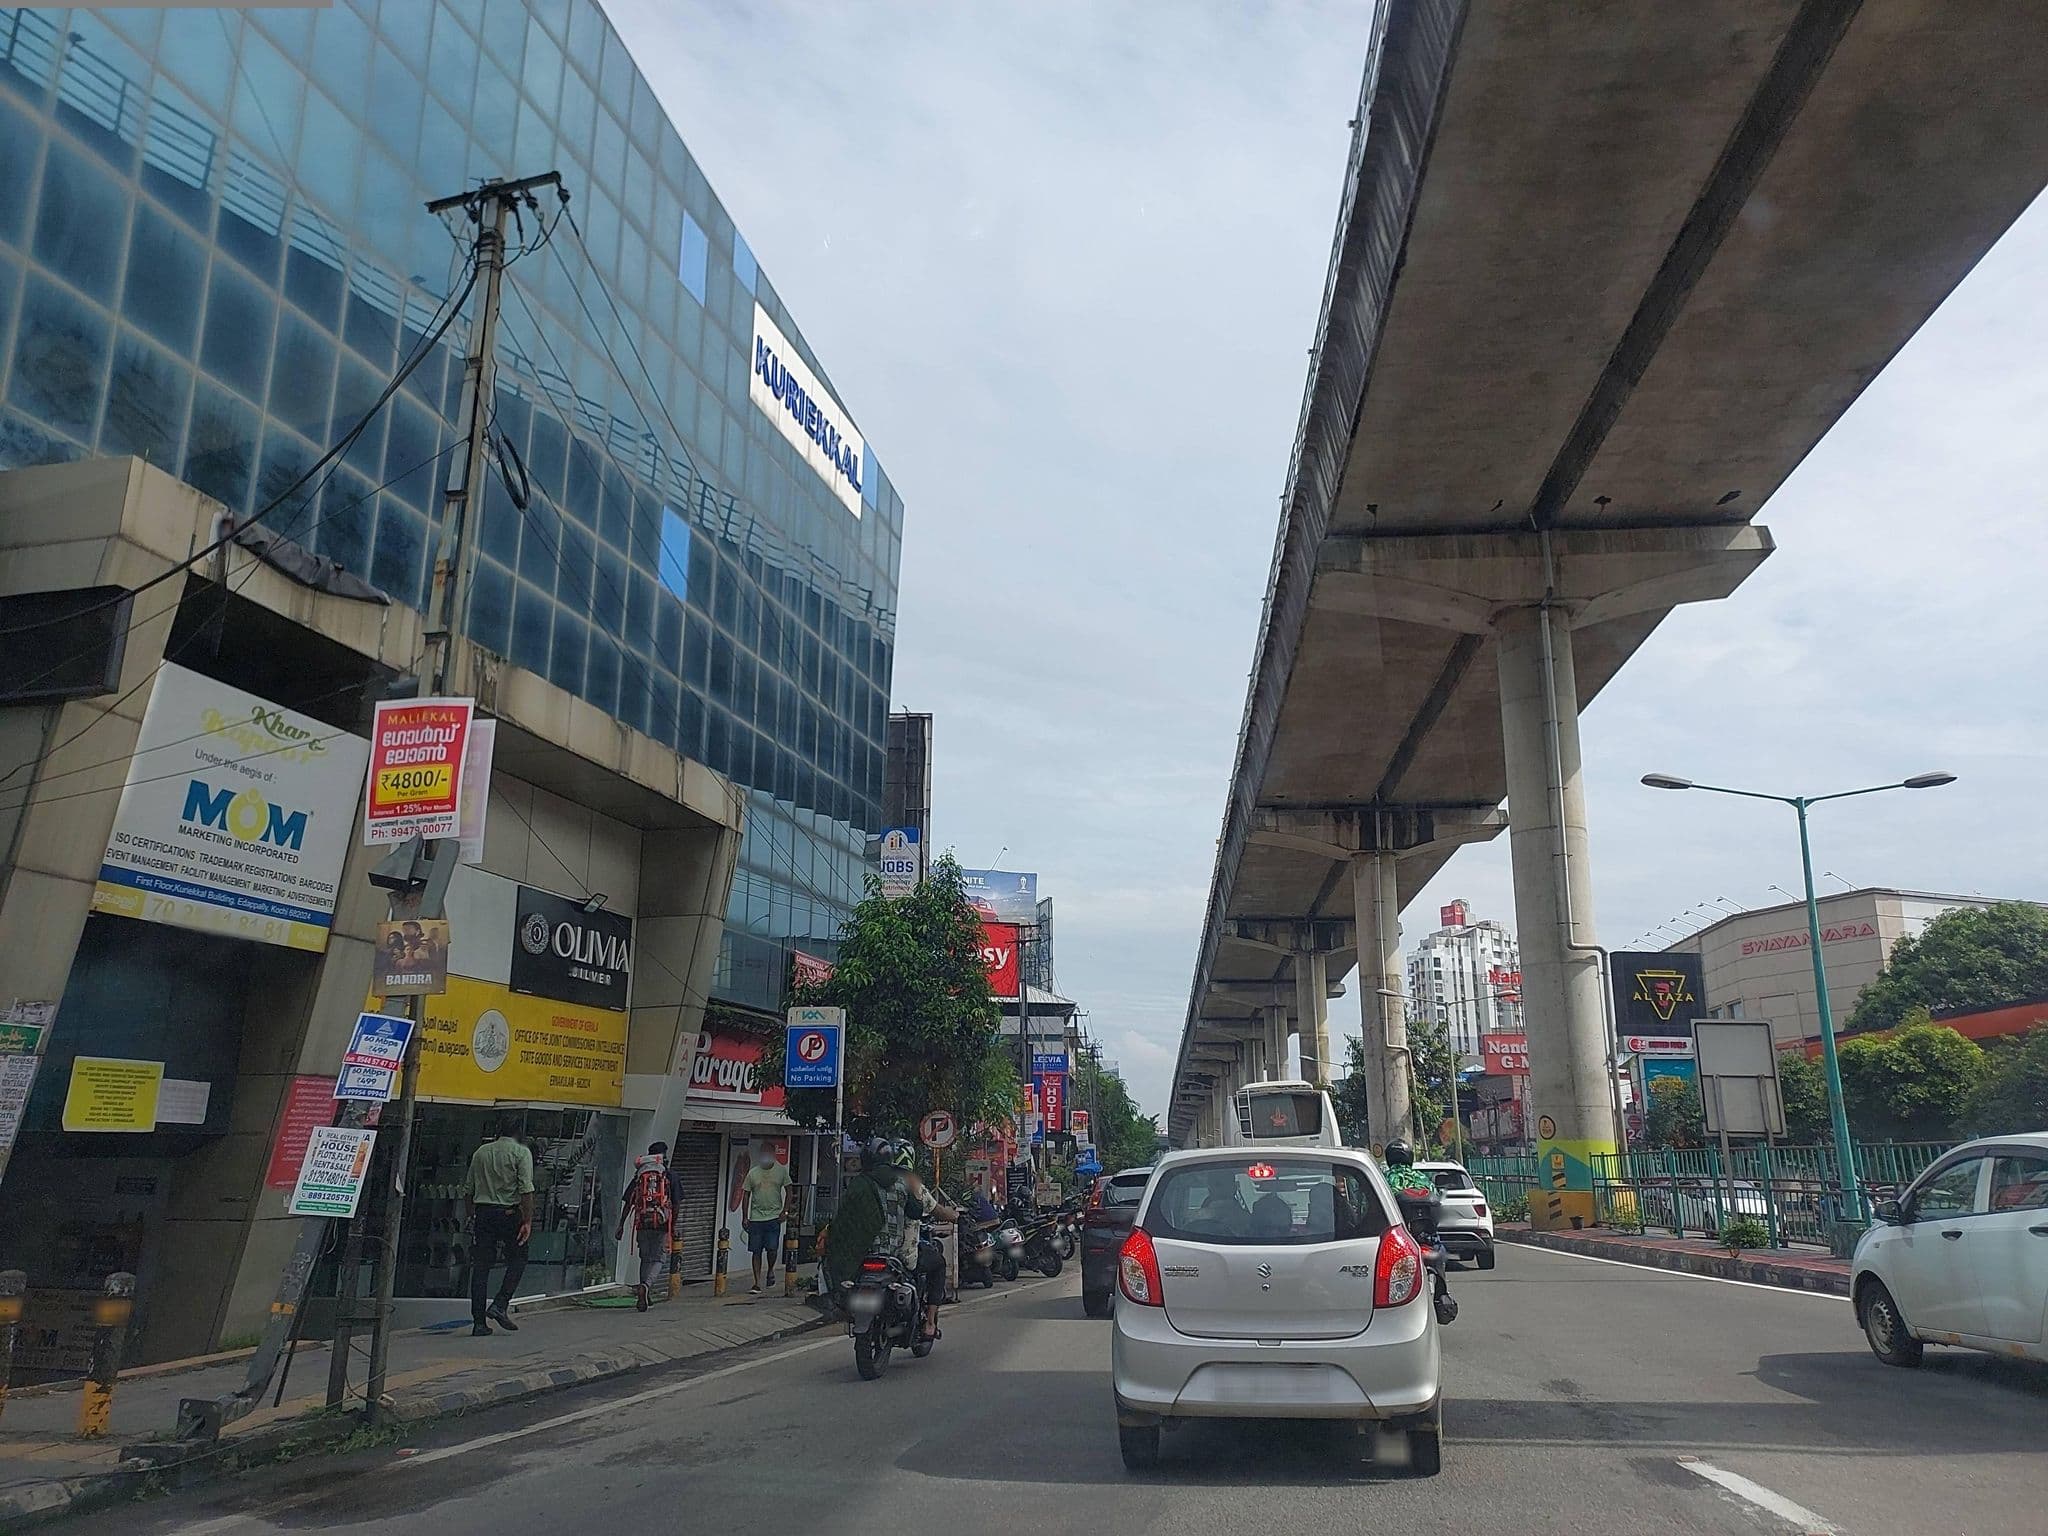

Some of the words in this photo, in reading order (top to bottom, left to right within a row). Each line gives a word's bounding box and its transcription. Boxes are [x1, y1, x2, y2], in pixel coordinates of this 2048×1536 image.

[756, 334, 861, 494] KURIEKKAL
[387, 711, 457, 726] MALIEKAL
[195, 748, 223, 766] Under
[240, 764, 262, 779] aegis
[182, 779, 309, 850] MOM
[396, 803, 422, 814] 1.25%
[422, 822, 453, 834] 00077
[178, 824, 233, 847] MARKETING
[233, 839, 299, 864] INCORPORATED
[115, 832, 131, 844] ISO
[131, 836, 196, 860] CERTIFICATIONS
[199, 852, 244, 872] TRADEMARK
[244, 863, 297, 885] REGISTRATIONS
[298, 877, 334, 894] BARCODES
[880, 860, 914, 873] JOBS
[106, 847, 131, 861] EVENT
[131, 853, 179, 873] MANAGEMENT
[179, 865, 208, 880] FACILITY
[207, 870, 252, 889] MANAGEMENT
[252, 881, 286, 898] MARKETING
[286, 890, 334, 908] ADVERTISEMENTS
[135, 875, 154, 887] First
[270, 904, 289, 916] Kochi
[554, 921, 630, 973] OLIVIA
[386, 973, 433, 986] BANDRA
[1633, 993, 1652, 1002] AL
[1657, 993, 1695, 1003] TAZA
[519, 1050, 535, 1065] STATE
[535, 1051, 552, 1066] GOODS
[791, 1074, 802, 1082] No
[804, 1074, 832, 1083] Parking
[1046, 1087, 1057, 1129] HOTEL
[320, 1140, 358, 1154] HOUSE
